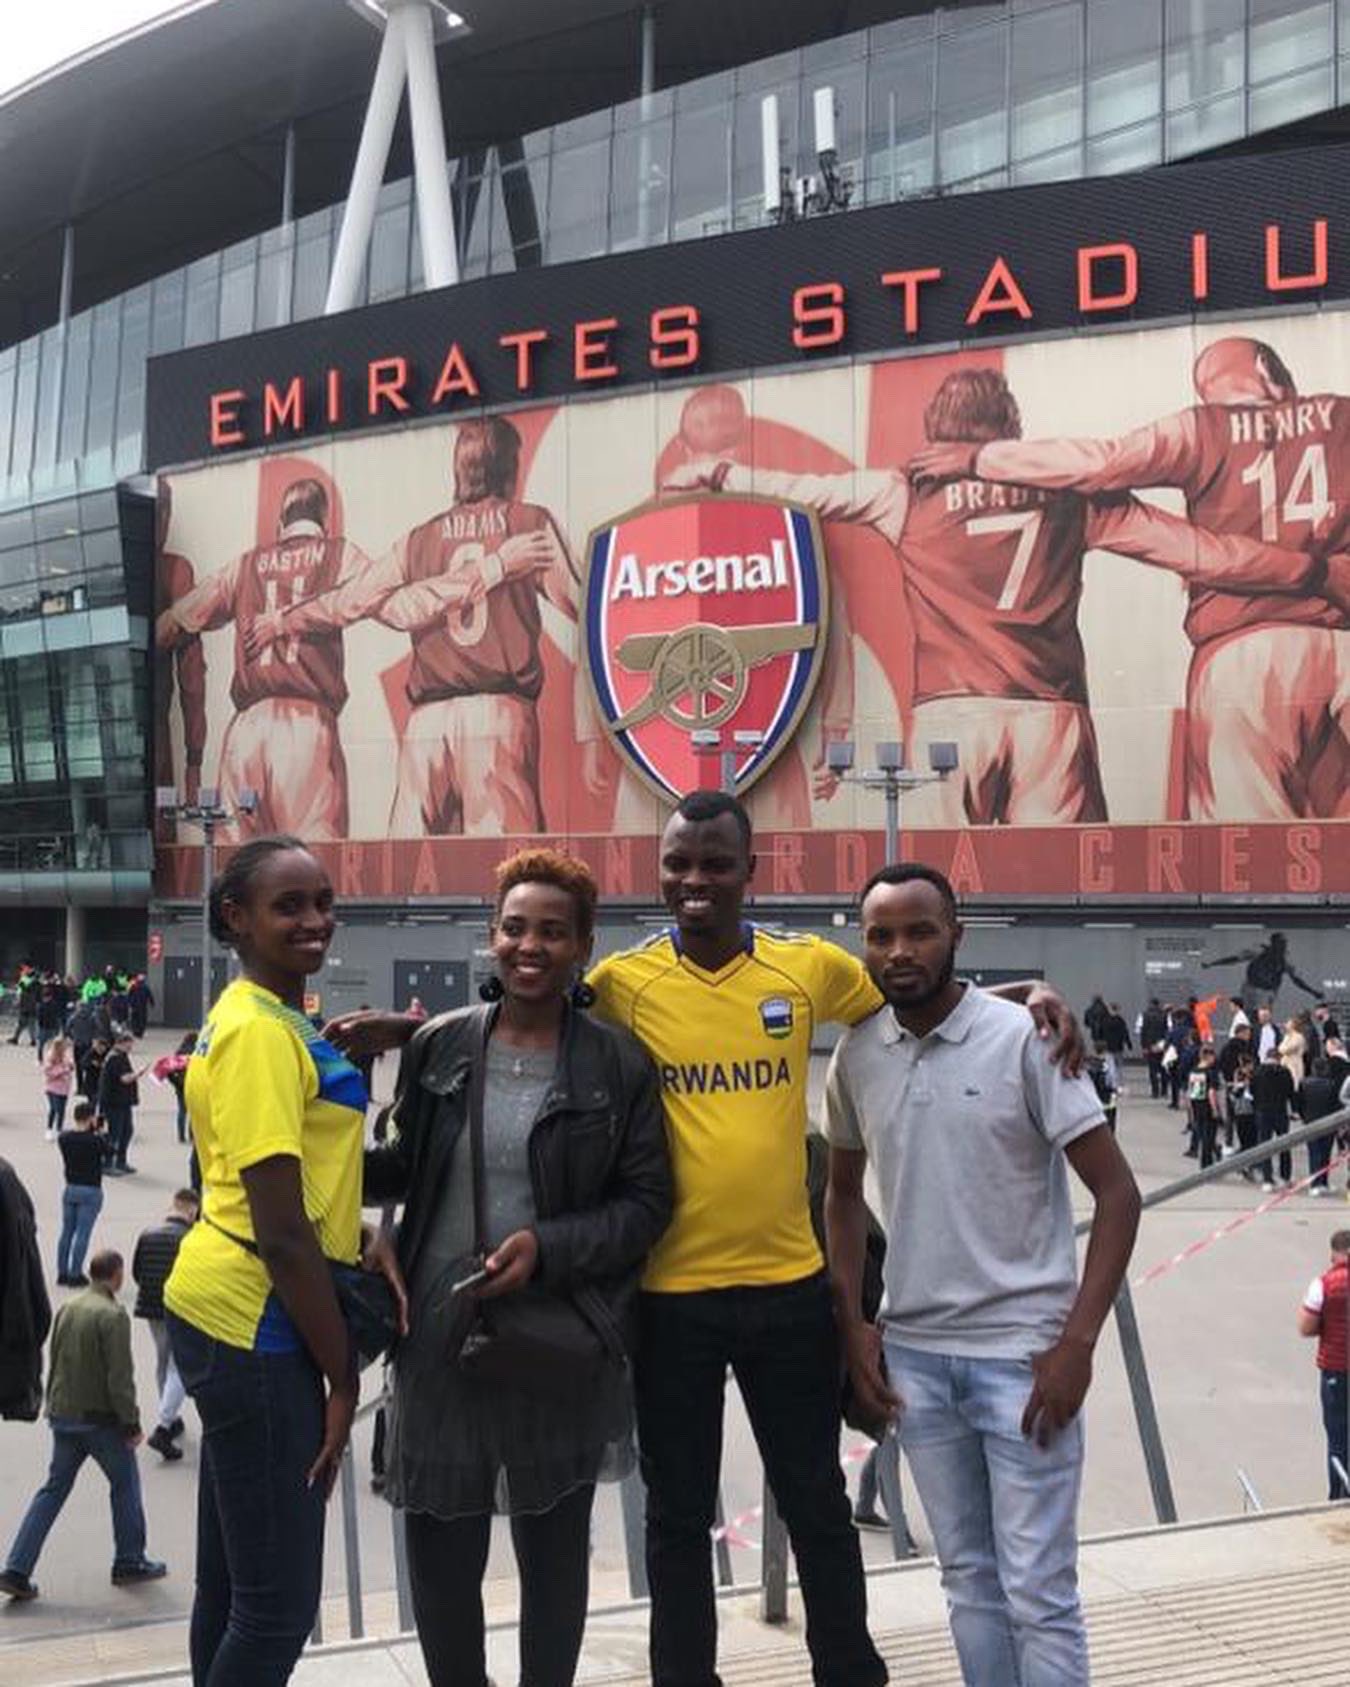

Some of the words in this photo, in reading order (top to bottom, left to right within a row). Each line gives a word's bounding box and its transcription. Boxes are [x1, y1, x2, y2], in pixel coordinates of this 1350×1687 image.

[210, 305, 699, 446] EMIRATES
[1230, 400, 1335, 444] HENRY
[1242, 444, 1336, 542] 14
[442, 510, 507, 540] ADAMS
[611, 538, 788, 601] Arsenal
[967, 510, 1042, 610] 7
[662, 1057, 791, 1095] RWANDA
